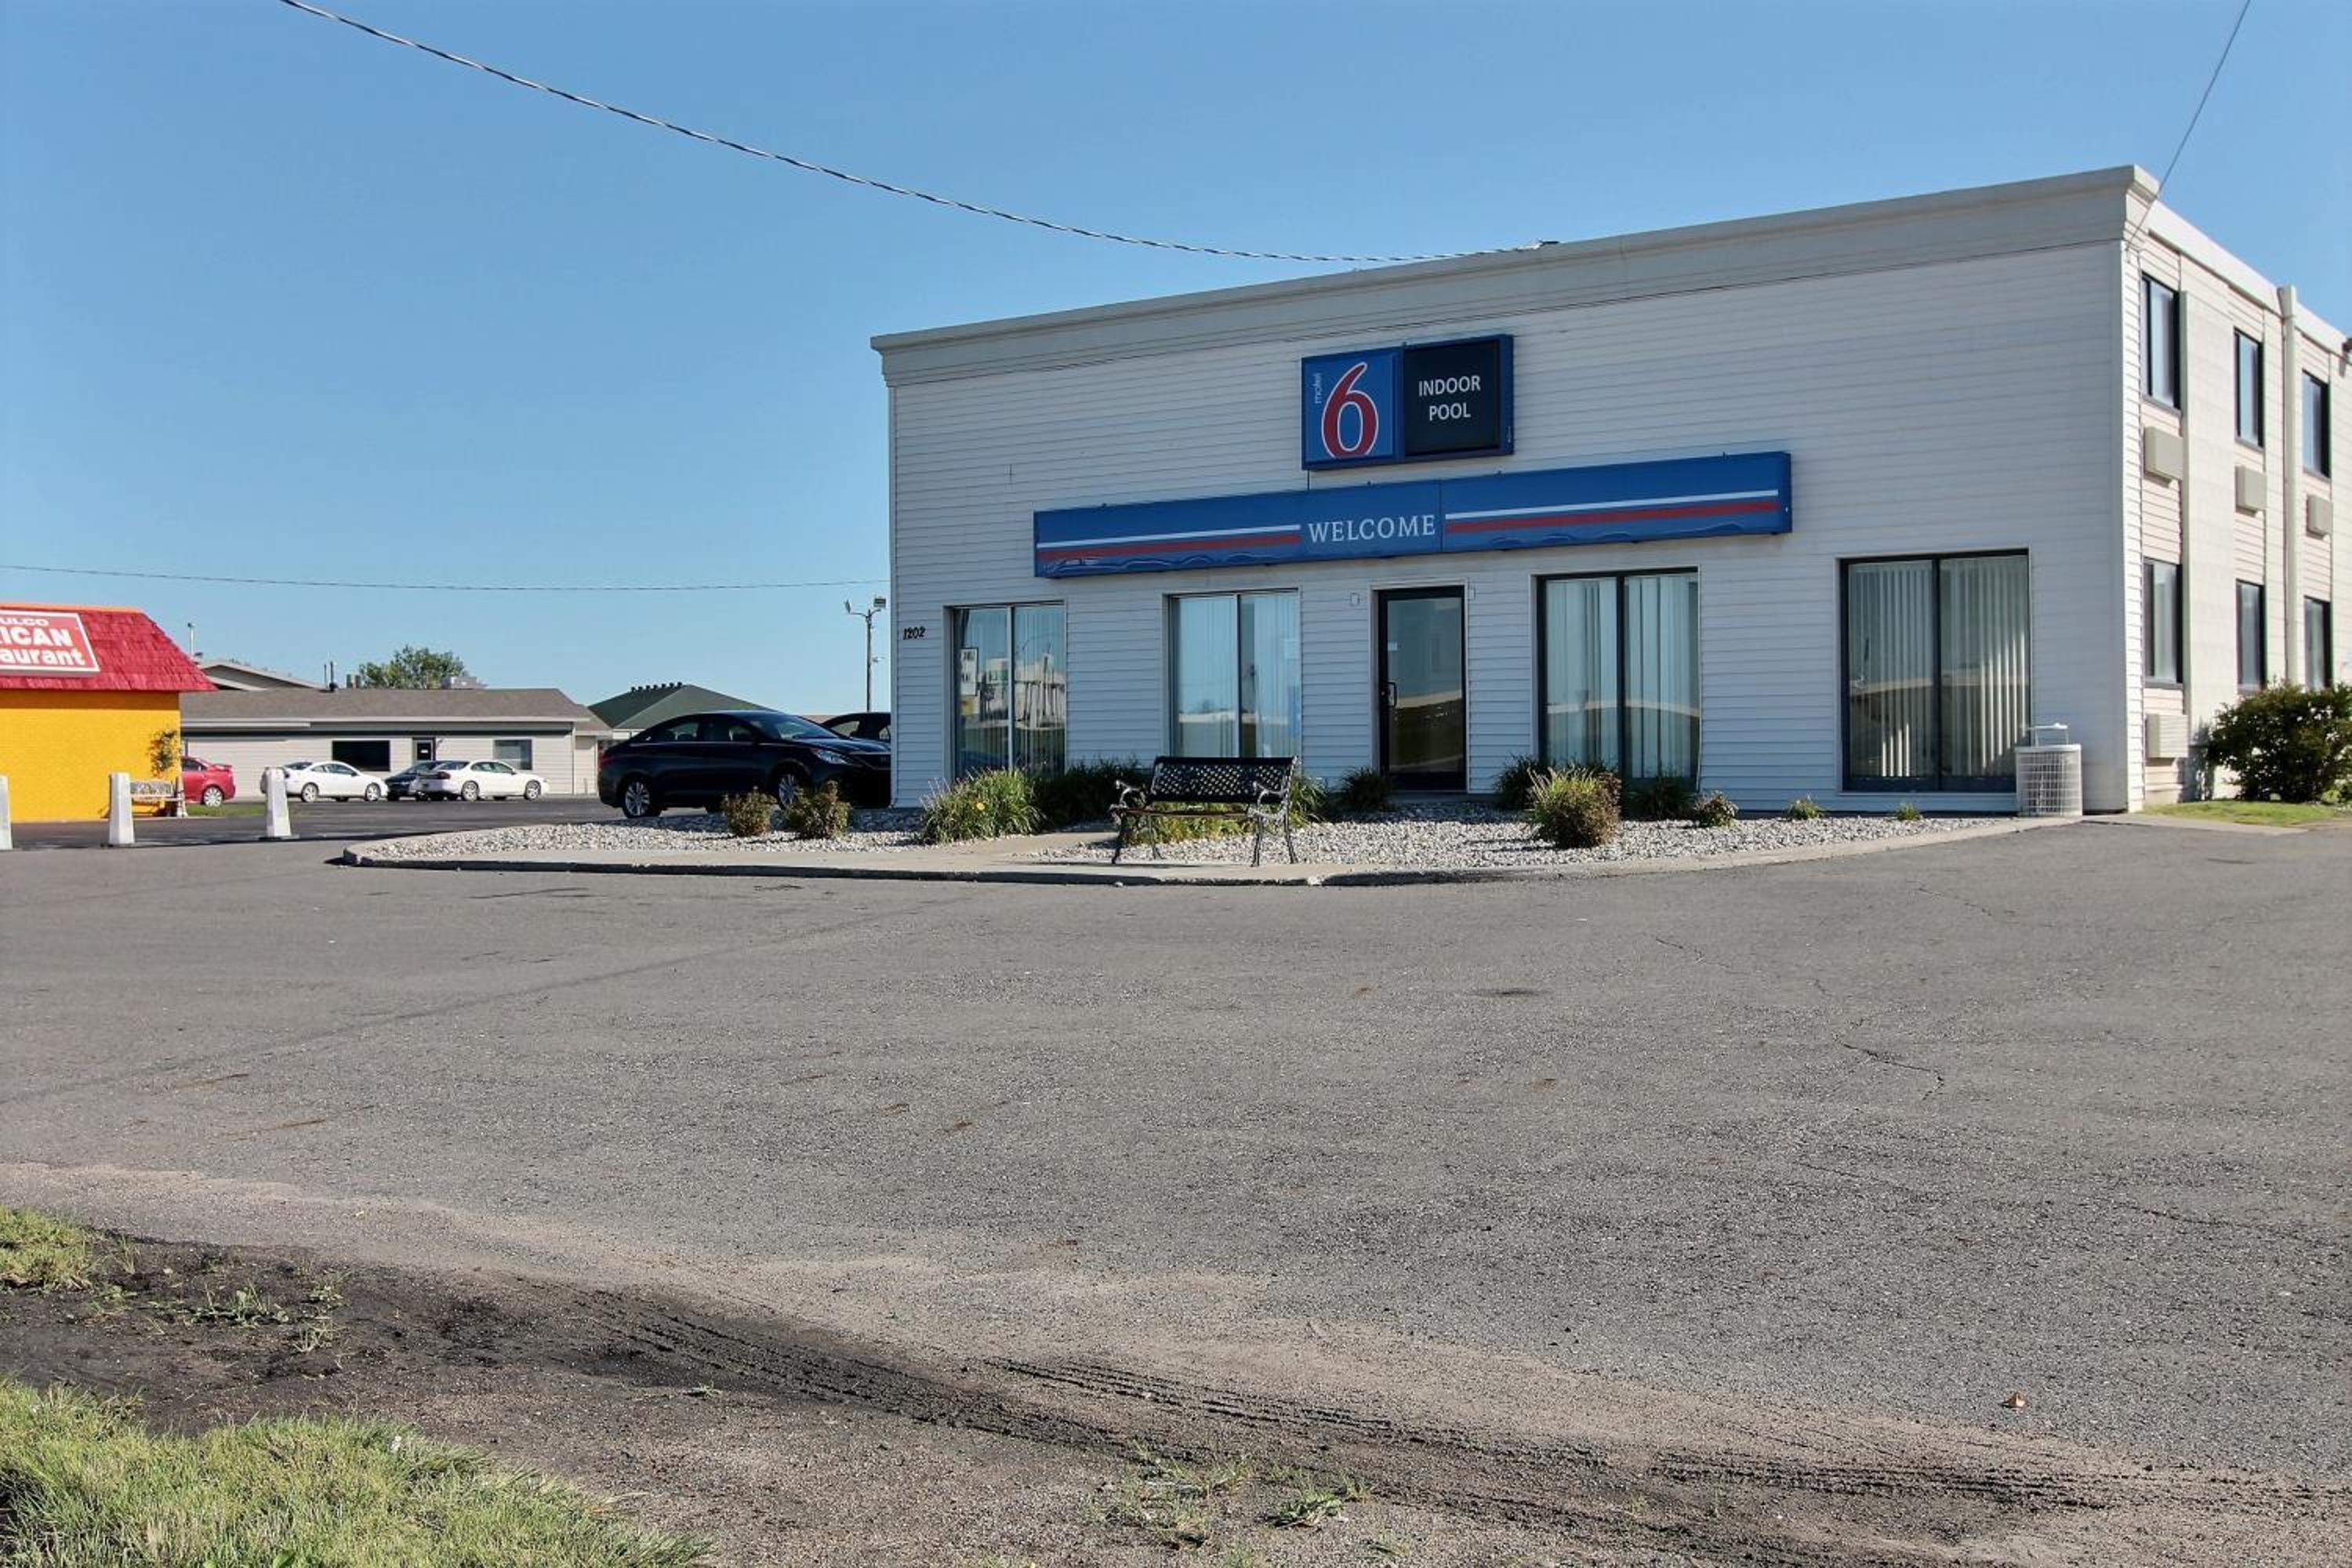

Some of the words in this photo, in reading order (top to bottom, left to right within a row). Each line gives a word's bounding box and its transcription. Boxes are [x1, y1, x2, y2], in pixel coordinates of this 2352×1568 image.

[1419, 376, 1480, 397] INDOOR
[1322, 362, 1378, 458] 6
[1429, 403, 1471, 421] POOL
[1307, 514, 1436, 543] WELCOME
[0, 626, 74, 646] ICAN
[903, 626, 926, 640] 1202
